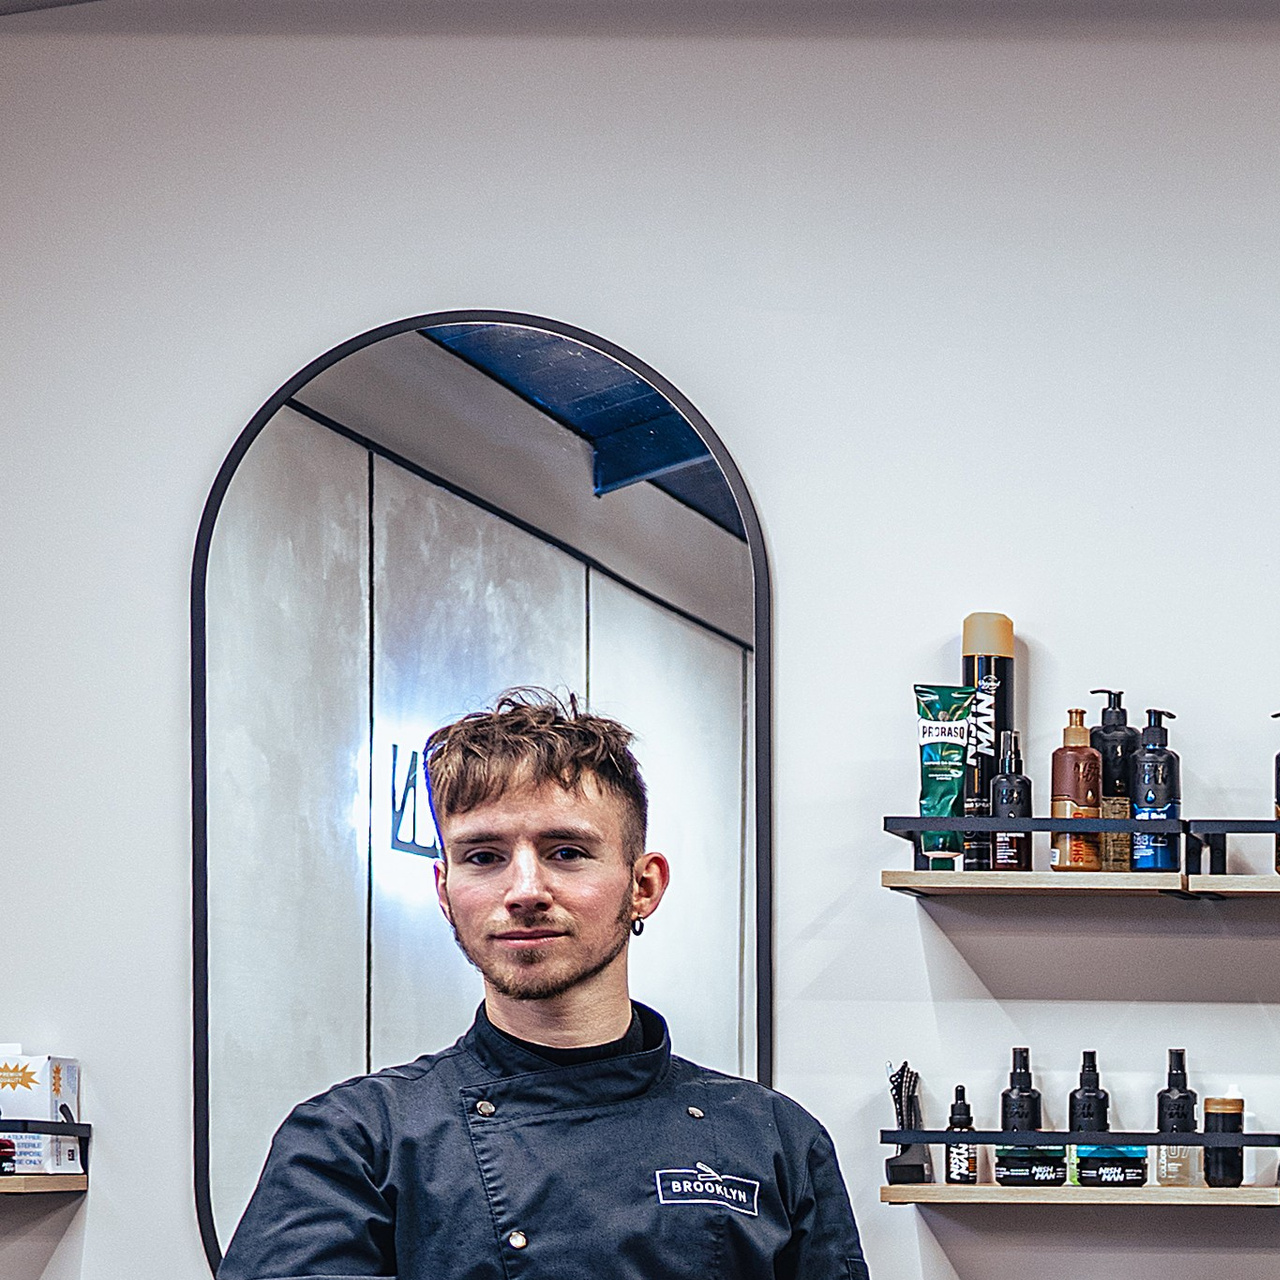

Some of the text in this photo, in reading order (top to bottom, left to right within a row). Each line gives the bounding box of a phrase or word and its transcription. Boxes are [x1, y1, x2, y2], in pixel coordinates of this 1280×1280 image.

[922, 725, 965, 740] PRORASO
[976, 691, 996, 757] MAN
[1072, 811, 1084, 863] SHAMO
[1031, 1165, 1054, 1174] NISH
[671, 1180, 747, 1203] BROOKLYN
